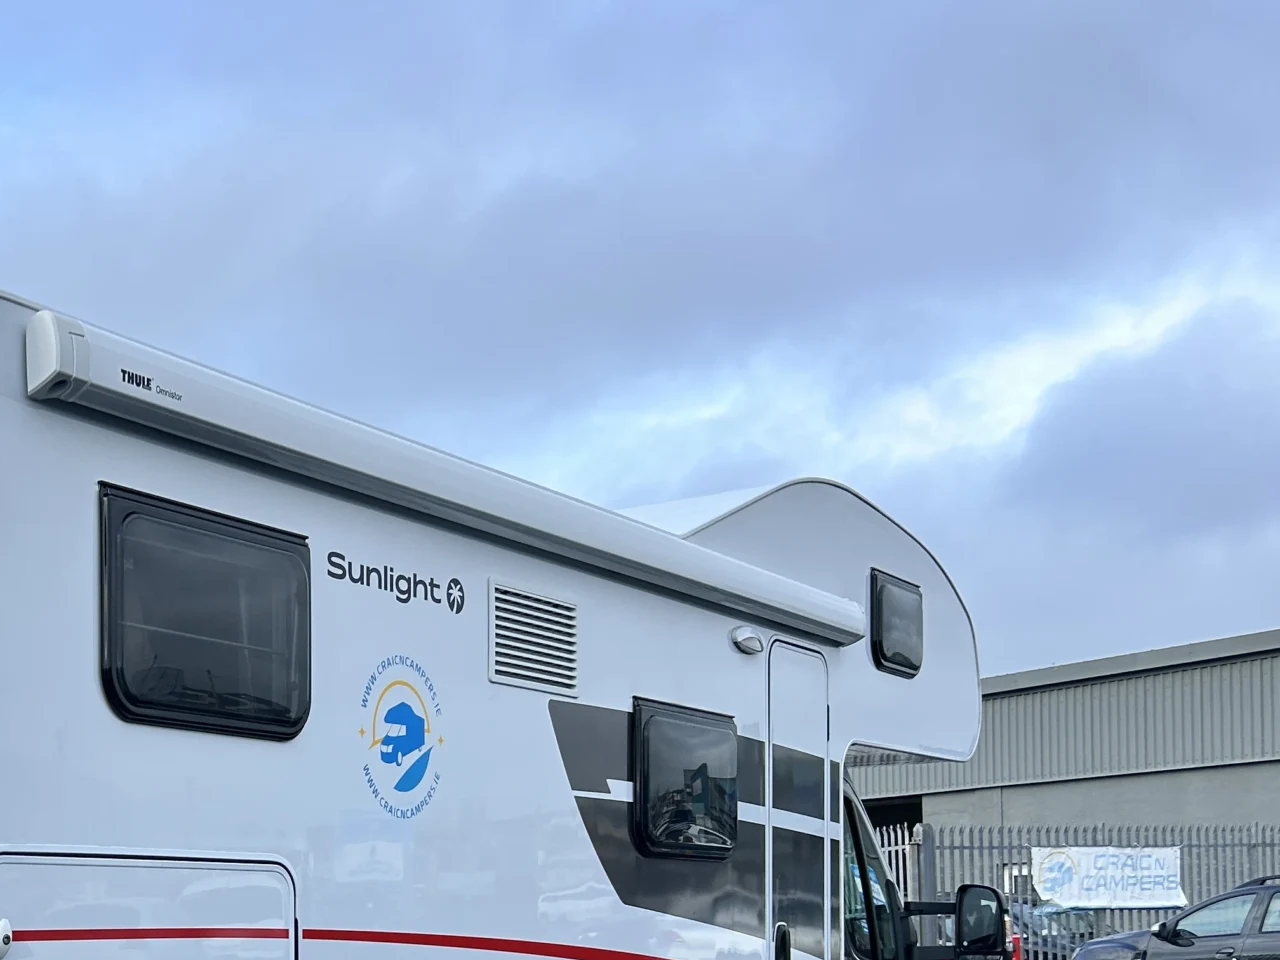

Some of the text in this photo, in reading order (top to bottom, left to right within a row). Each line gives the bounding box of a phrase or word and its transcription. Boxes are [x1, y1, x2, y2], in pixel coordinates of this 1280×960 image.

[120, 368, 183, 401] THULE Omnistor
[327, 551, 441, 604] Sunlight
[1093, 854, 1166, 871] CRAIC N
[1081, 874, 1180, 892] CAMPERS
